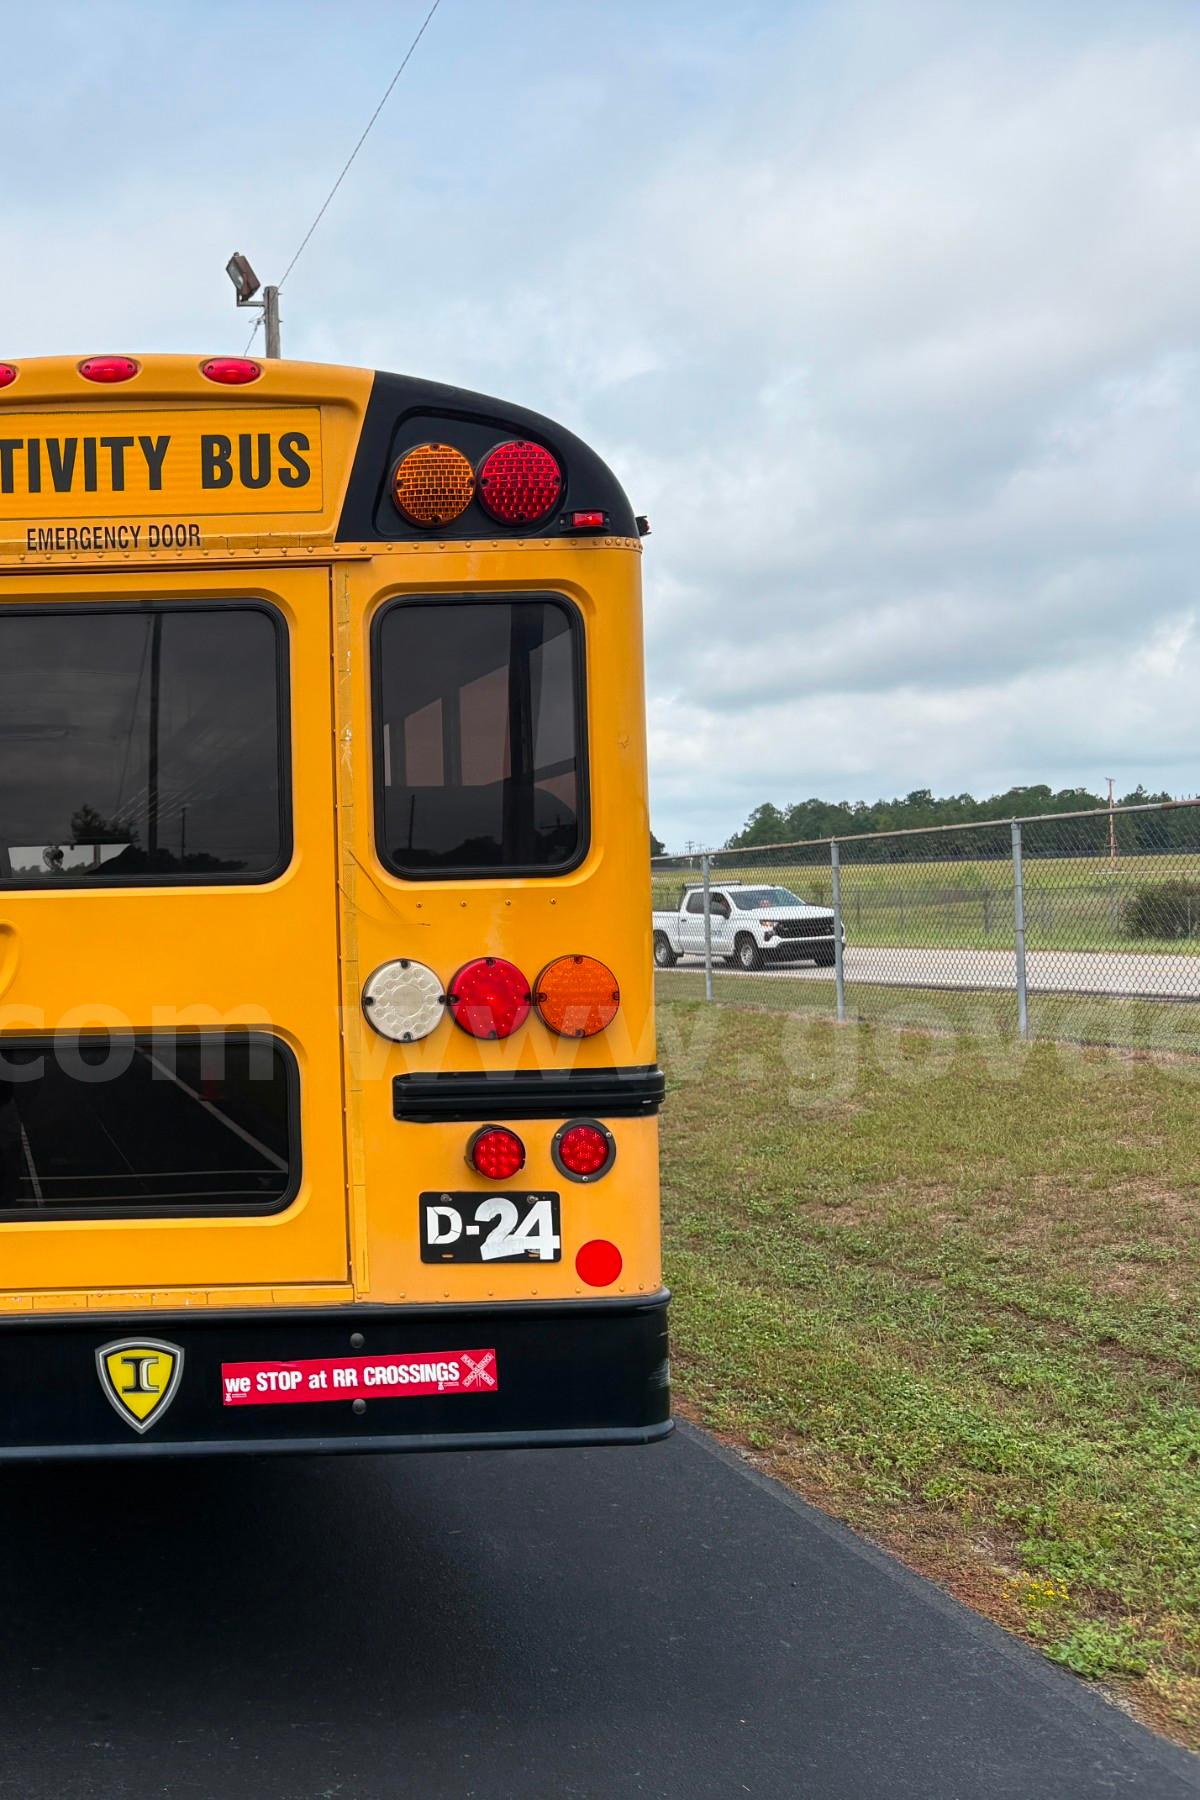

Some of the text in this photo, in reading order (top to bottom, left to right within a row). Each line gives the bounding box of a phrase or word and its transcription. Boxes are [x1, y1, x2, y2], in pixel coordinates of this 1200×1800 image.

[201, 431, 311, 489] BUS
[27, 523, 200, 551] EMERGENCY DOOR
[426, 1197, 560, 1261] D-24
[224, 1361, 460, 1392] we STOP at RR CROSSINGS
